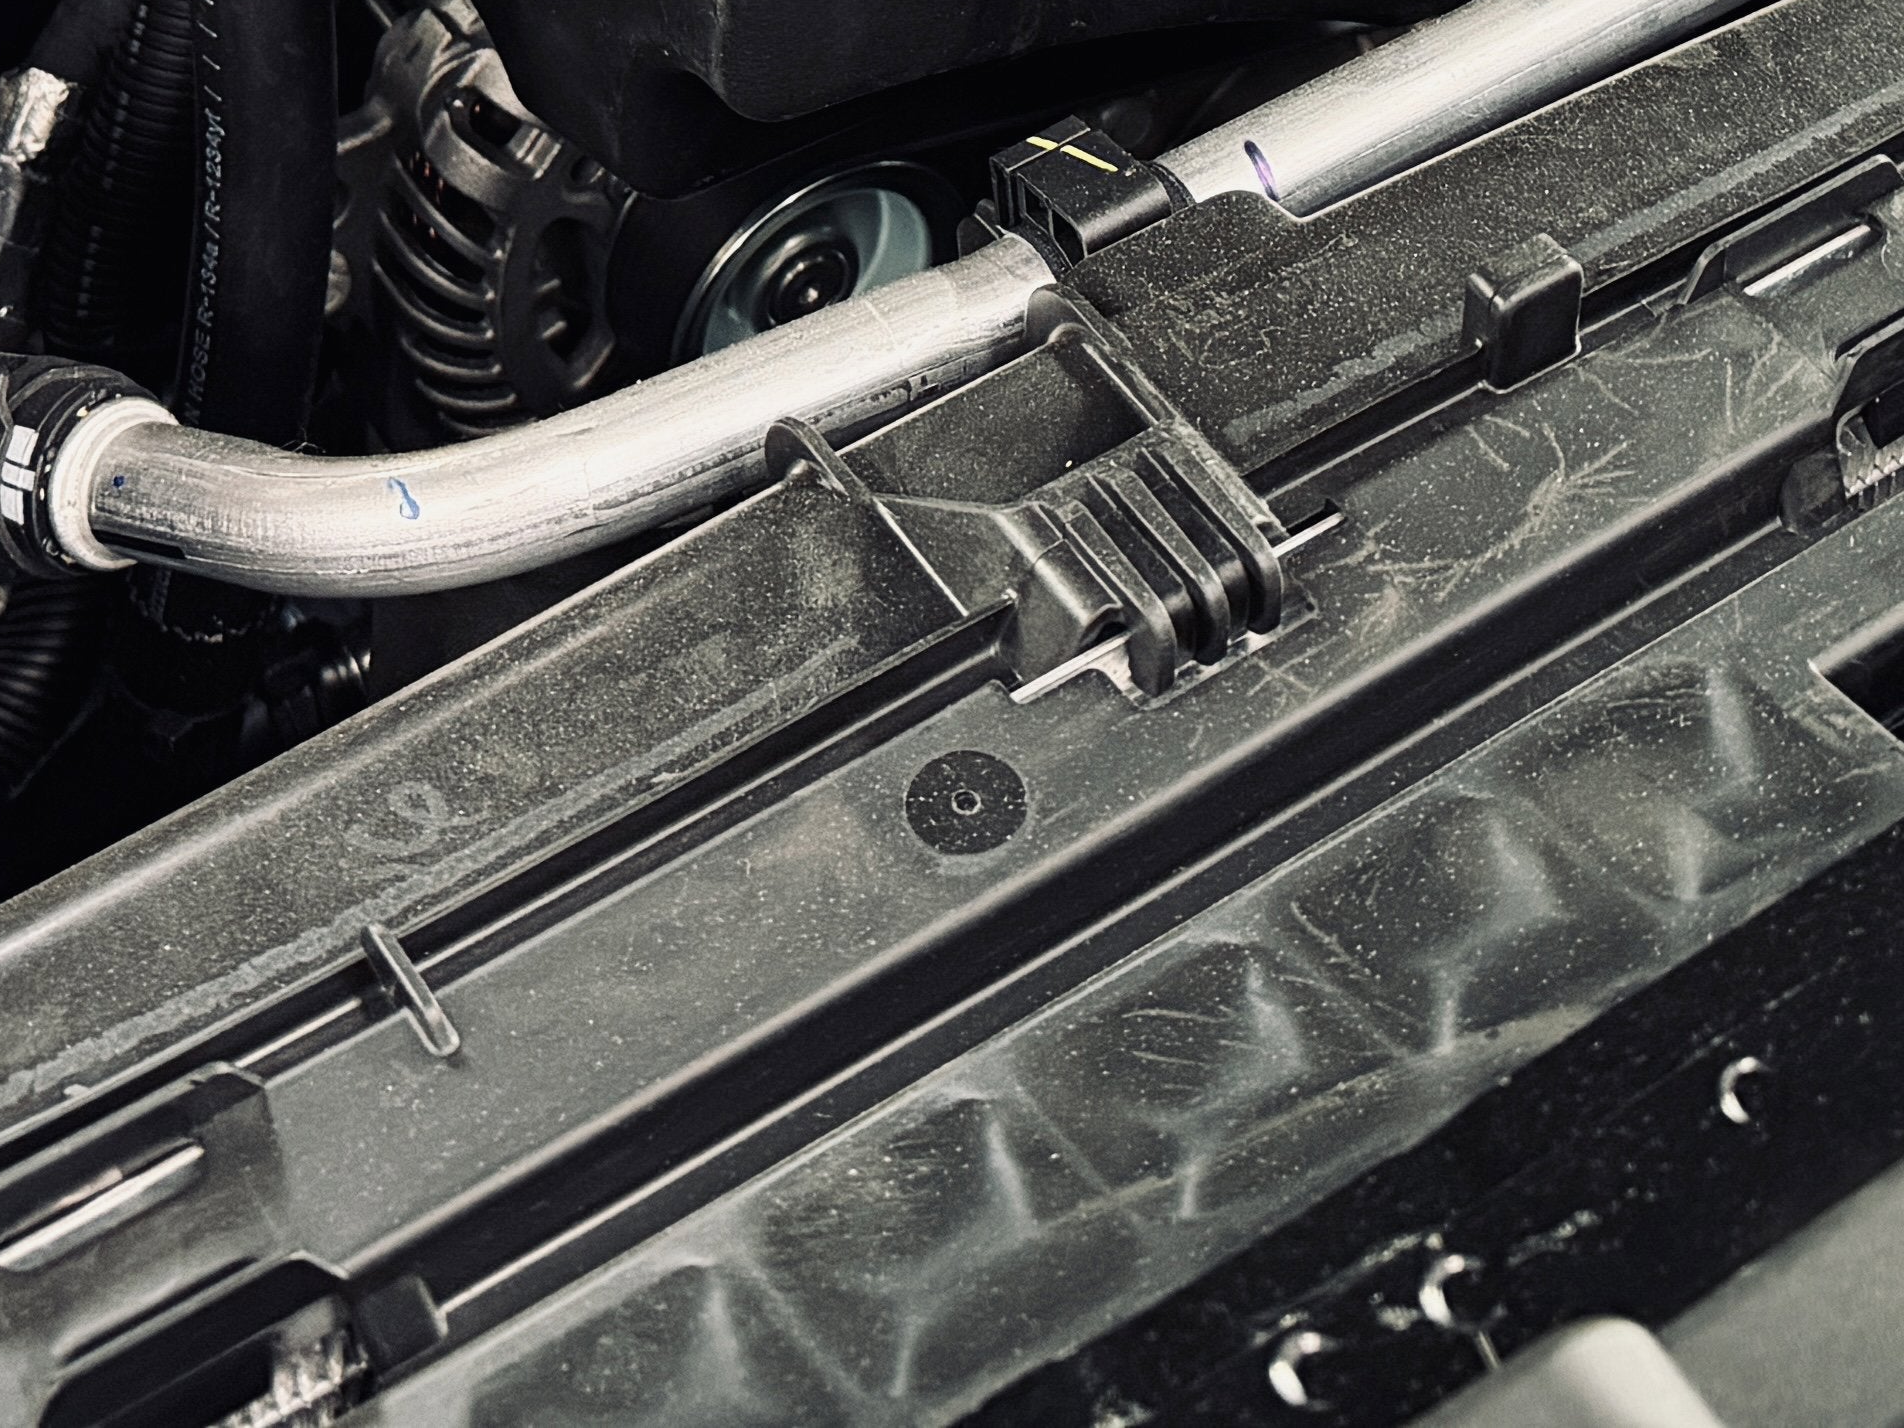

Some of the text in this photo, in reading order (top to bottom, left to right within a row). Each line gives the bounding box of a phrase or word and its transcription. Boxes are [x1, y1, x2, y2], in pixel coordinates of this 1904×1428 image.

[203, 106, 227, 222] R-1234yf
[196, 240, 220, 328] R-134a
[187, 327, 212, 403] HOSE
